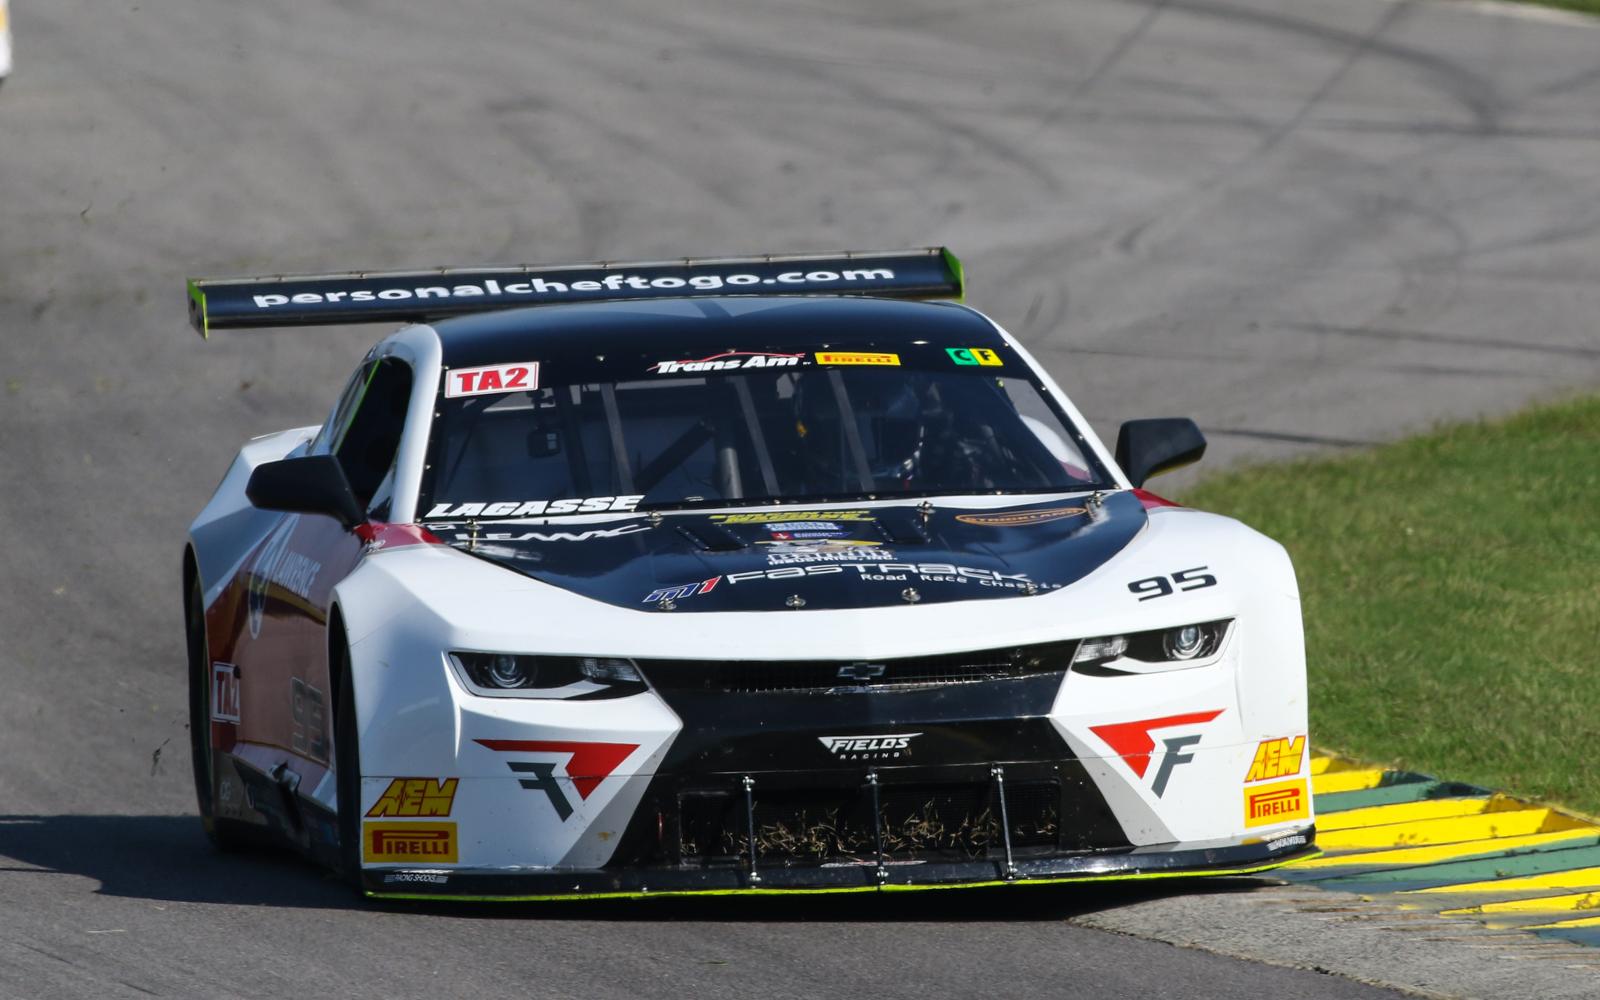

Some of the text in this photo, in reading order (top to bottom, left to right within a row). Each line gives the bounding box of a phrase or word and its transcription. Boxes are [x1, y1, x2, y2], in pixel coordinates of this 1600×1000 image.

[252, 267, 896, 308] personalcheftogo.com
[655, 355, 799, 374] Trans Am
[457, 366, 528, 393] TA2
[860, 573, 907, 582] Road
[920, 574, 968, 584] Race
[1128, 566, 1218, 602] 95
[825, 735, 914, 753] FIELDS
[840, 752, 900, 760] RACING
[1244, 735, 1306, 783] AEM
[364, 777, 460, 818] AEM
[1249, 788, 1300, 819] PIRELLI
[372, 829, 450, 855] PIRELLI
